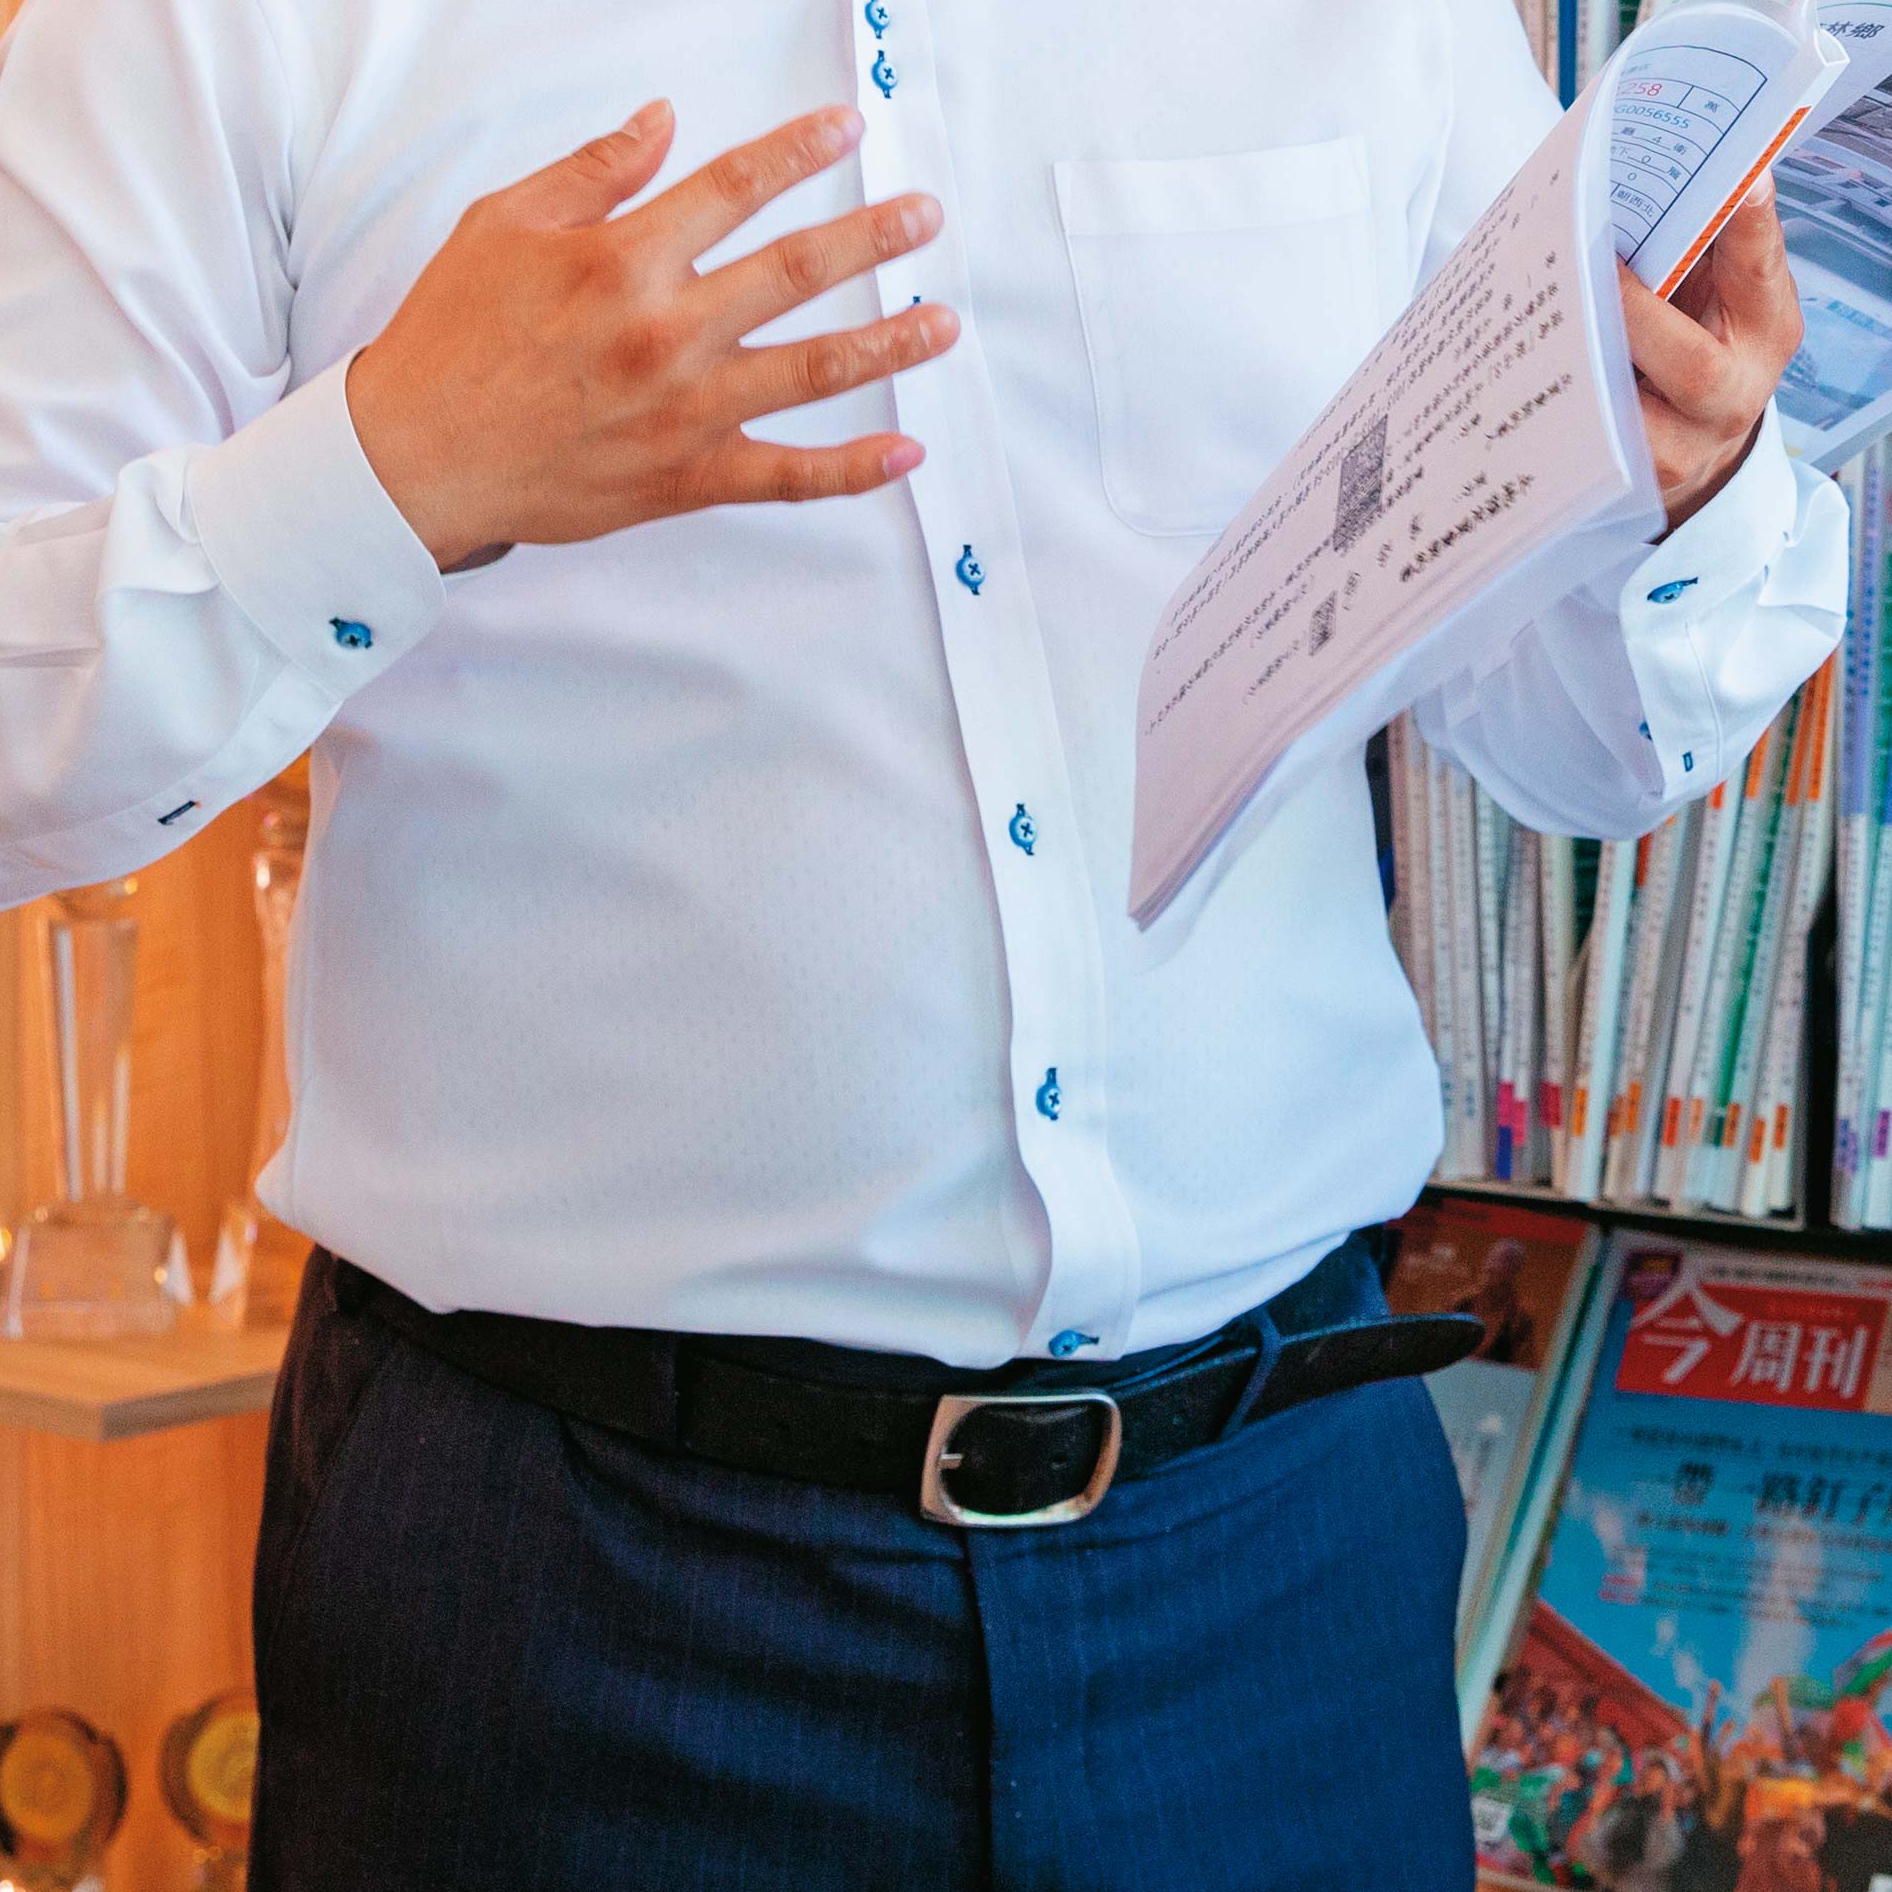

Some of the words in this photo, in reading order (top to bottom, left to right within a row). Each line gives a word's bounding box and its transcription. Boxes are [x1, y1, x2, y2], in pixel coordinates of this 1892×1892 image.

[1615, 190, 1656, 218] 朝西北
[1631, 1256, 1868, 1399] 今周刊
